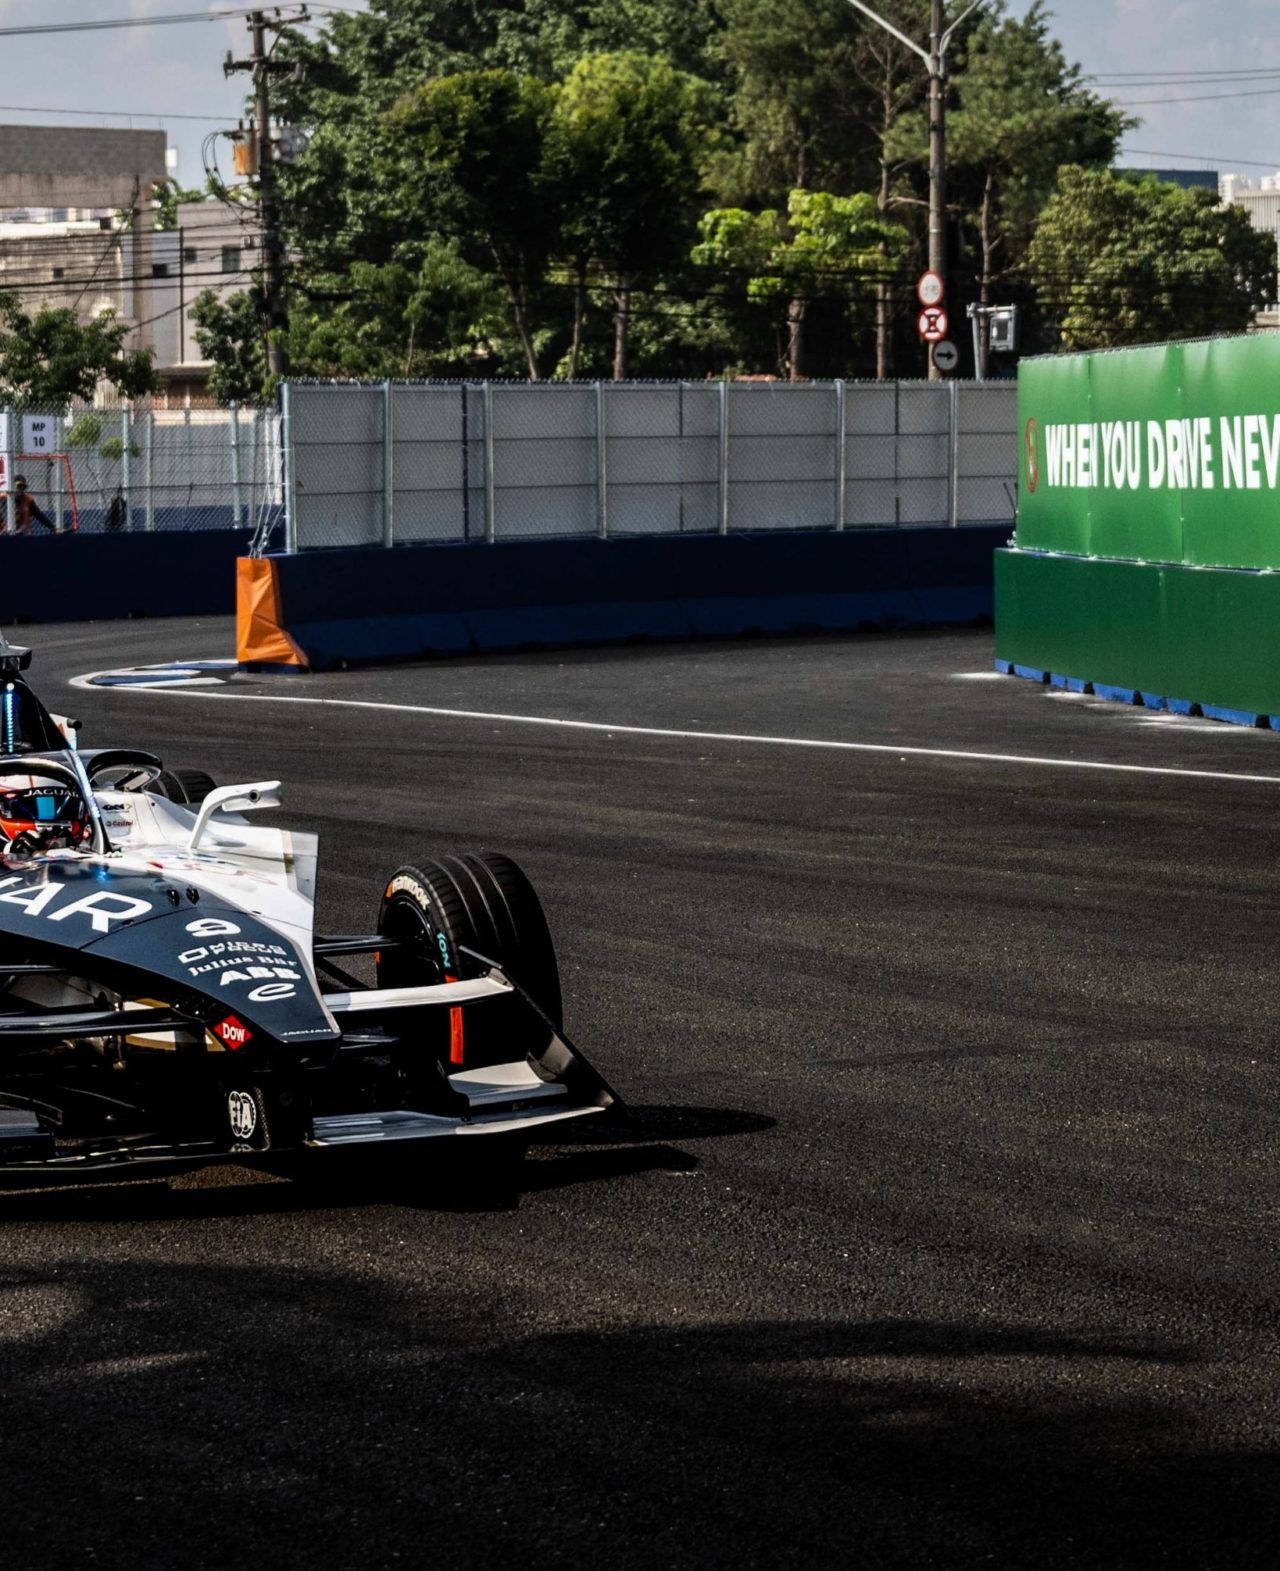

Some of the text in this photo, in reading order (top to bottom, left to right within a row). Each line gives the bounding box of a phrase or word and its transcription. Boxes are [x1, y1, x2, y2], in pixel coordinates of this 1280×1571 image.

[32, 422, 46, 431] MP
[33, 436, 45, 447] 10
[1045, 422, 1098, 487] WHEN
[1101, 420, 1140, 490] YOU
[1147, 417, 1214, 489] DRIVE
[188, 956, 253, 976] Julius
[220, 967, 301, 986] ABB
[229, 1099, 252, 1129] FIA
